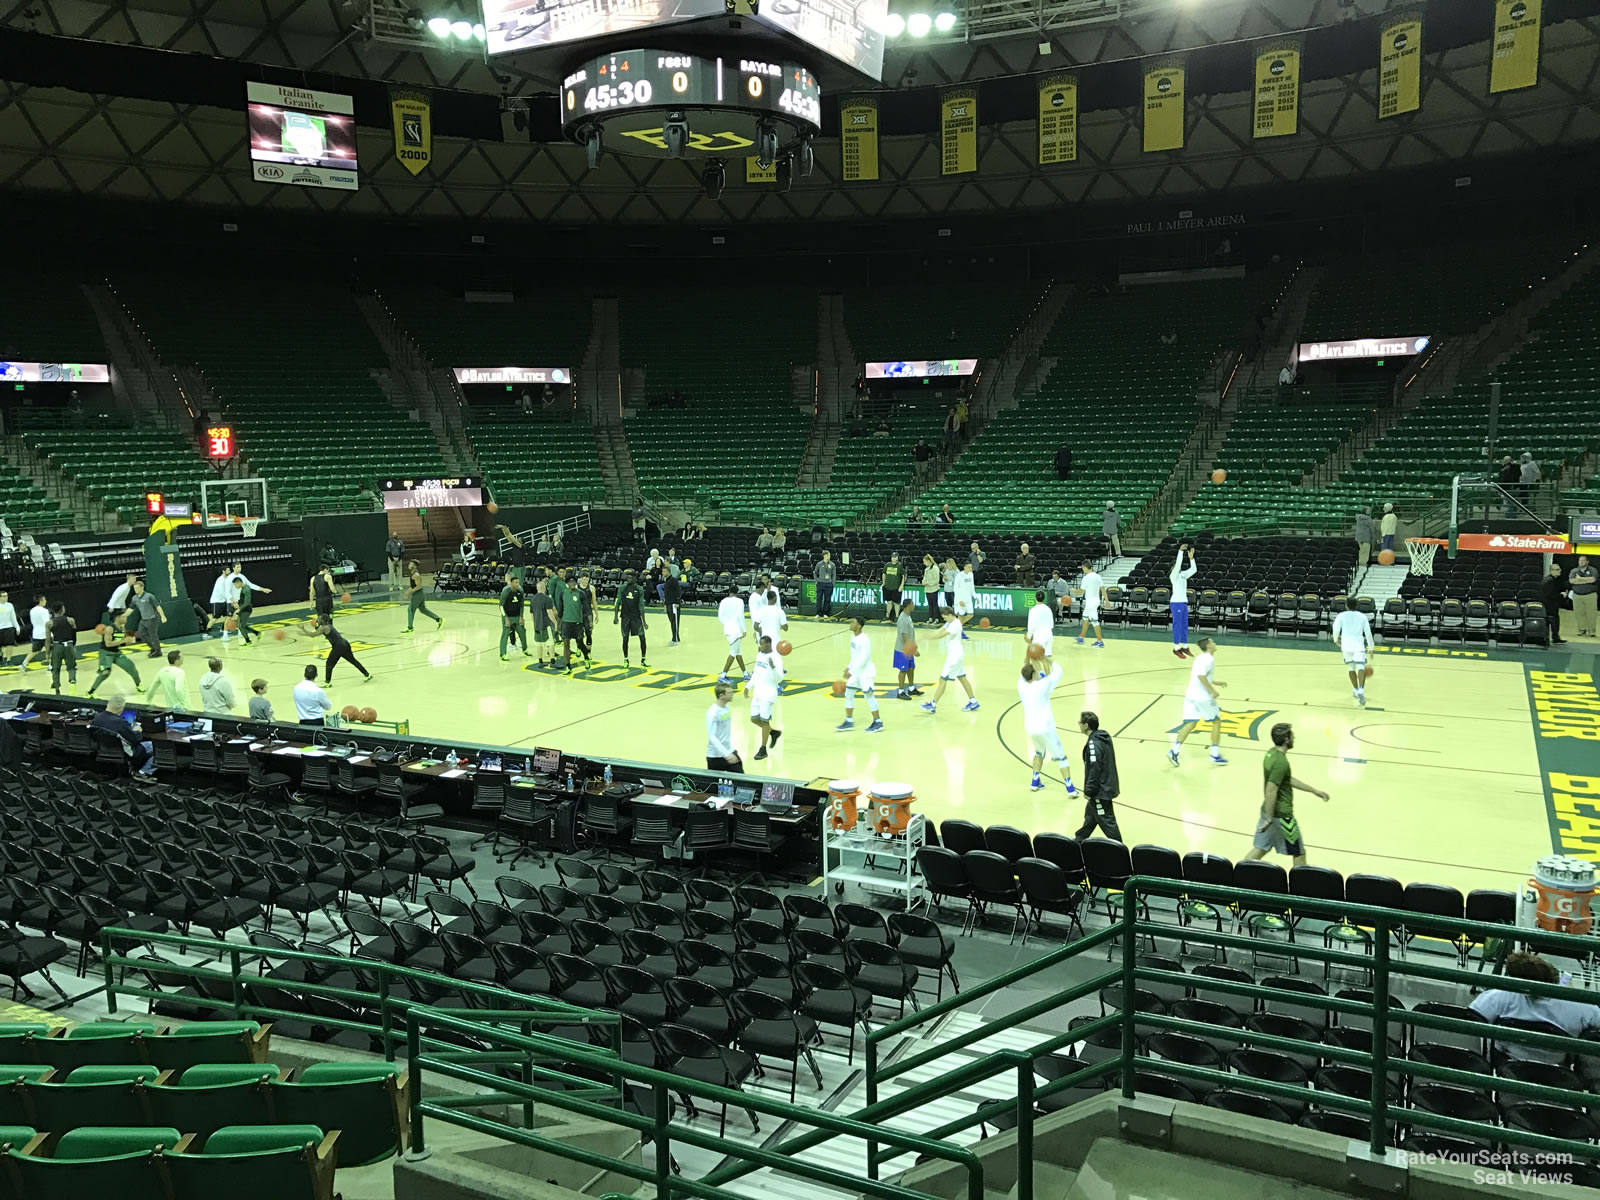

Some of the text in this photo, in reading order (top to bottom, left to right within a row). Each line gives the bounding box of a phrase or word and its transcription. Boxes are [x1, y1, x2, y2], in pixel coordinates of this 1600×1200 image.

[599, 64, 608, 75] 4
[620, 60, 629, 71] 4
[740, 59, 782, 77] BAYLOR
[672, 71, 688, 93] 0
[748, 76, 763, 97] 0
[278, 87, 314, 100] Italian
[567, 90, 575, 110] 0
[584, 79, 652, 111] 45:30
[284, 97, 325, 110] Granite
[400, 150, 428, 161] 2000
[262, 169, 280, 177] KIA
[1127, 222, 1153, 233] PAUL
[1166, 218, 1205, 231] MEYER
[1206, 213, 1246, 227] ARENA
[207, 427, 230, 438] 45:30
[210, 438, 229, 455] 30
[403, 497, 460, 508] BASKETBALL
[830, 587, 877, 605] WELCOME
[974, 593, 1013, 611] ARENA
[1529, 670, 1600, 742] BAYLOR
[833, 798, 843, 810] G
[879, 805, 890, 817] G
[1557, 898, 1573, 913] G
